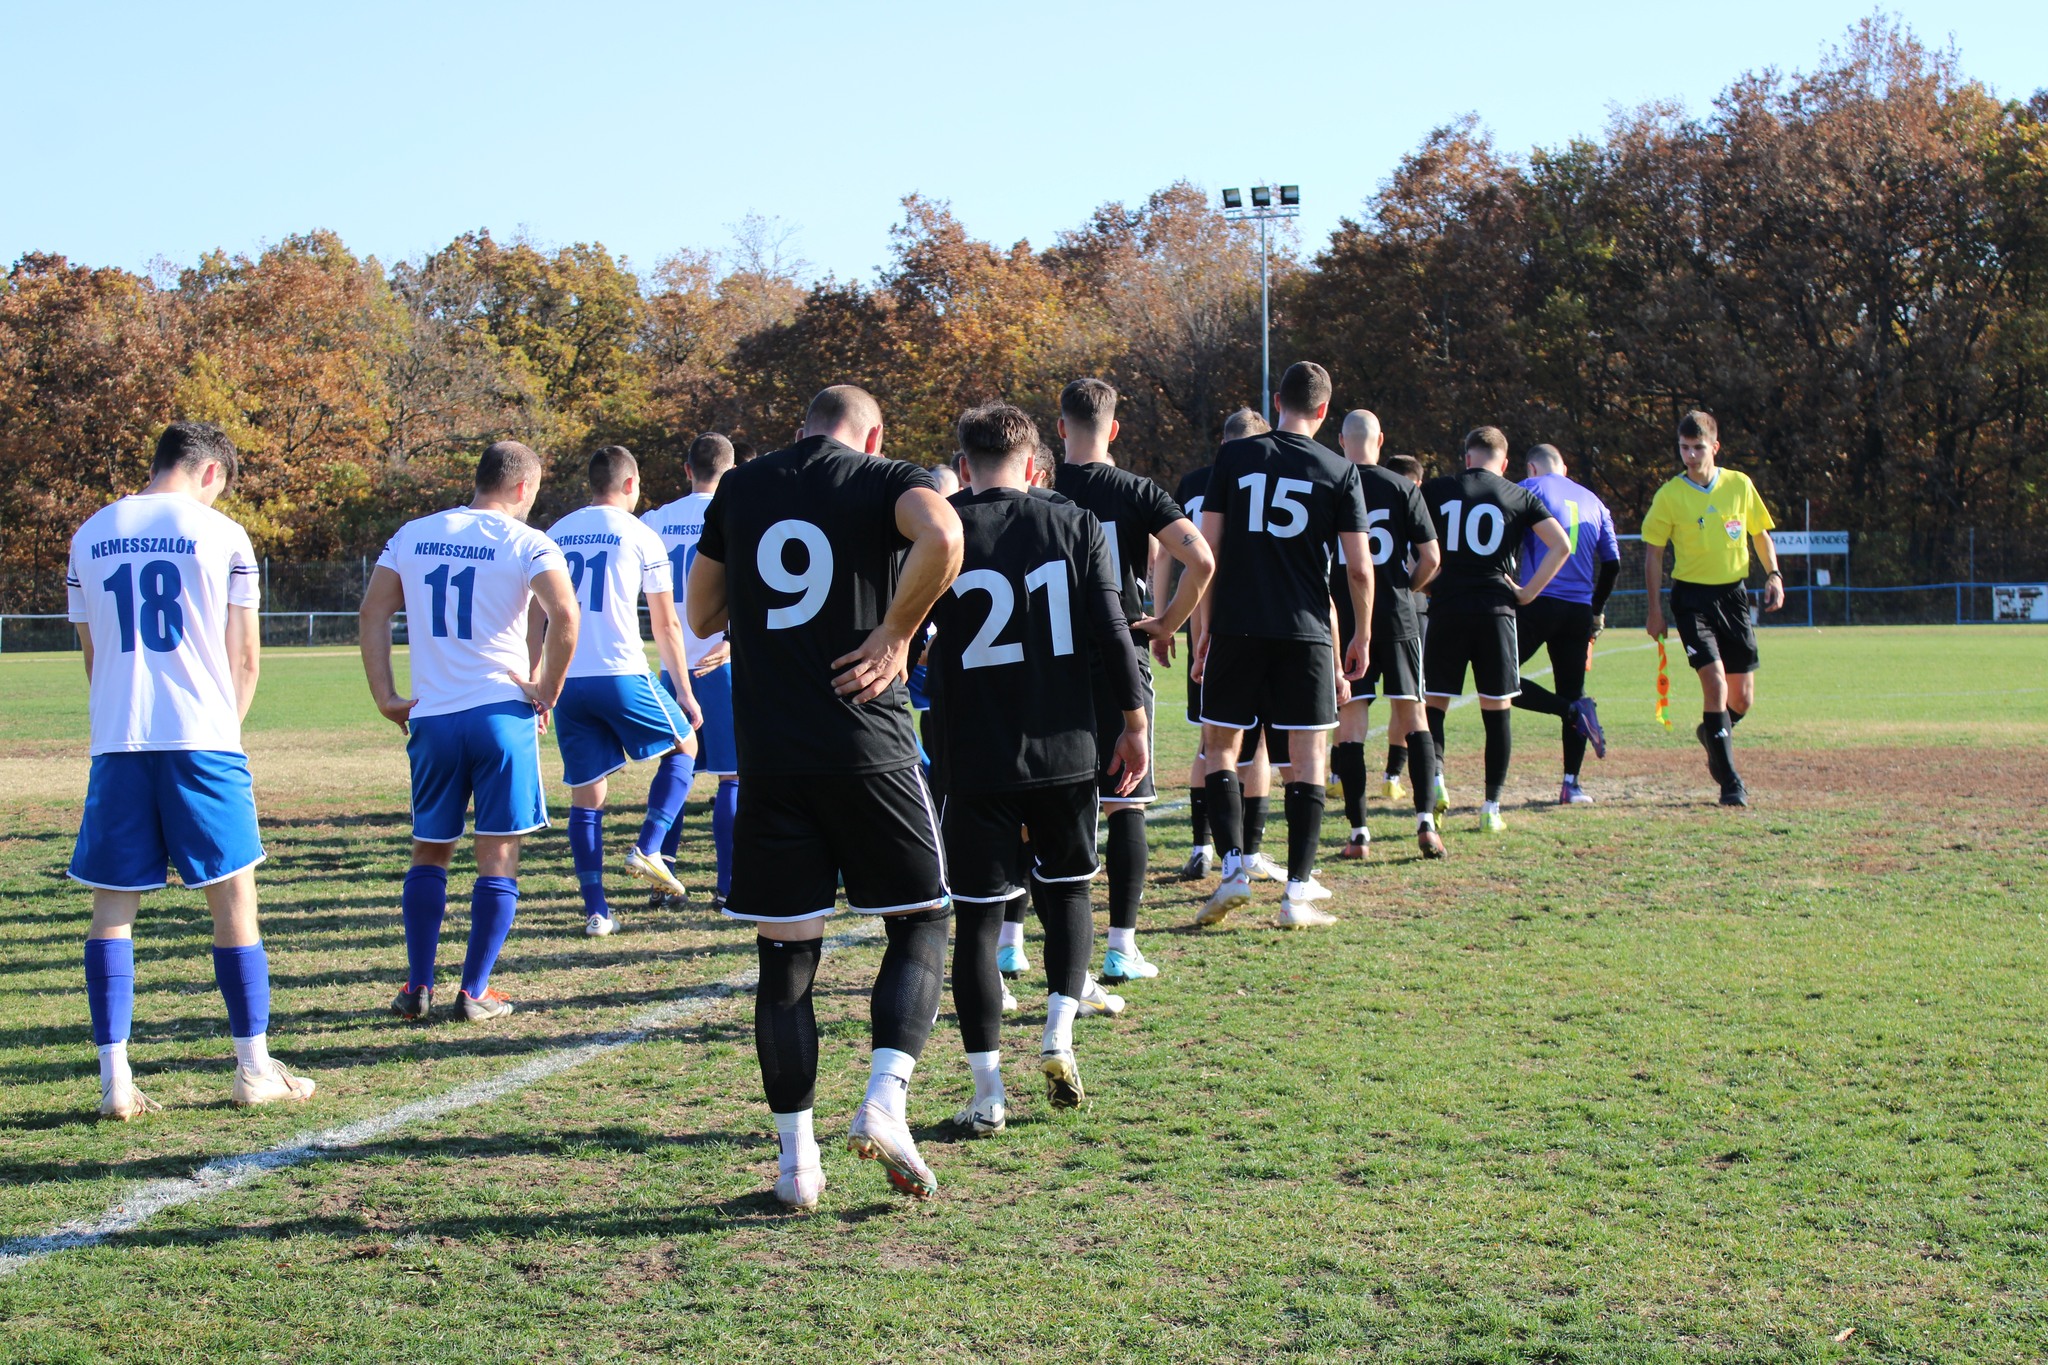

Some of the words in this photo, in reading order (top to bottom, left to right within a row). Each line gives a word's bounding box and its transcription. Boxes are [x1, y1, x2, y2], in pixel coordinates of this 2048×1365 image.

[1238, 472, 1313, 539] 15
[1440, 499, 1505, 556] 10
[1564, 499, 1579, 555] 1
[91, 536, 198, 560] NEMESSZALÓK
[414, 542, 496, 561] NEMESSZALÓK
[1337, 508, 1395, 566] 6
[424, 563, 477, 640] 11
[757, 519, 834, 630] 9
[103, 559, 184, 653] 18
[951, 559, 1075, 670] 21
